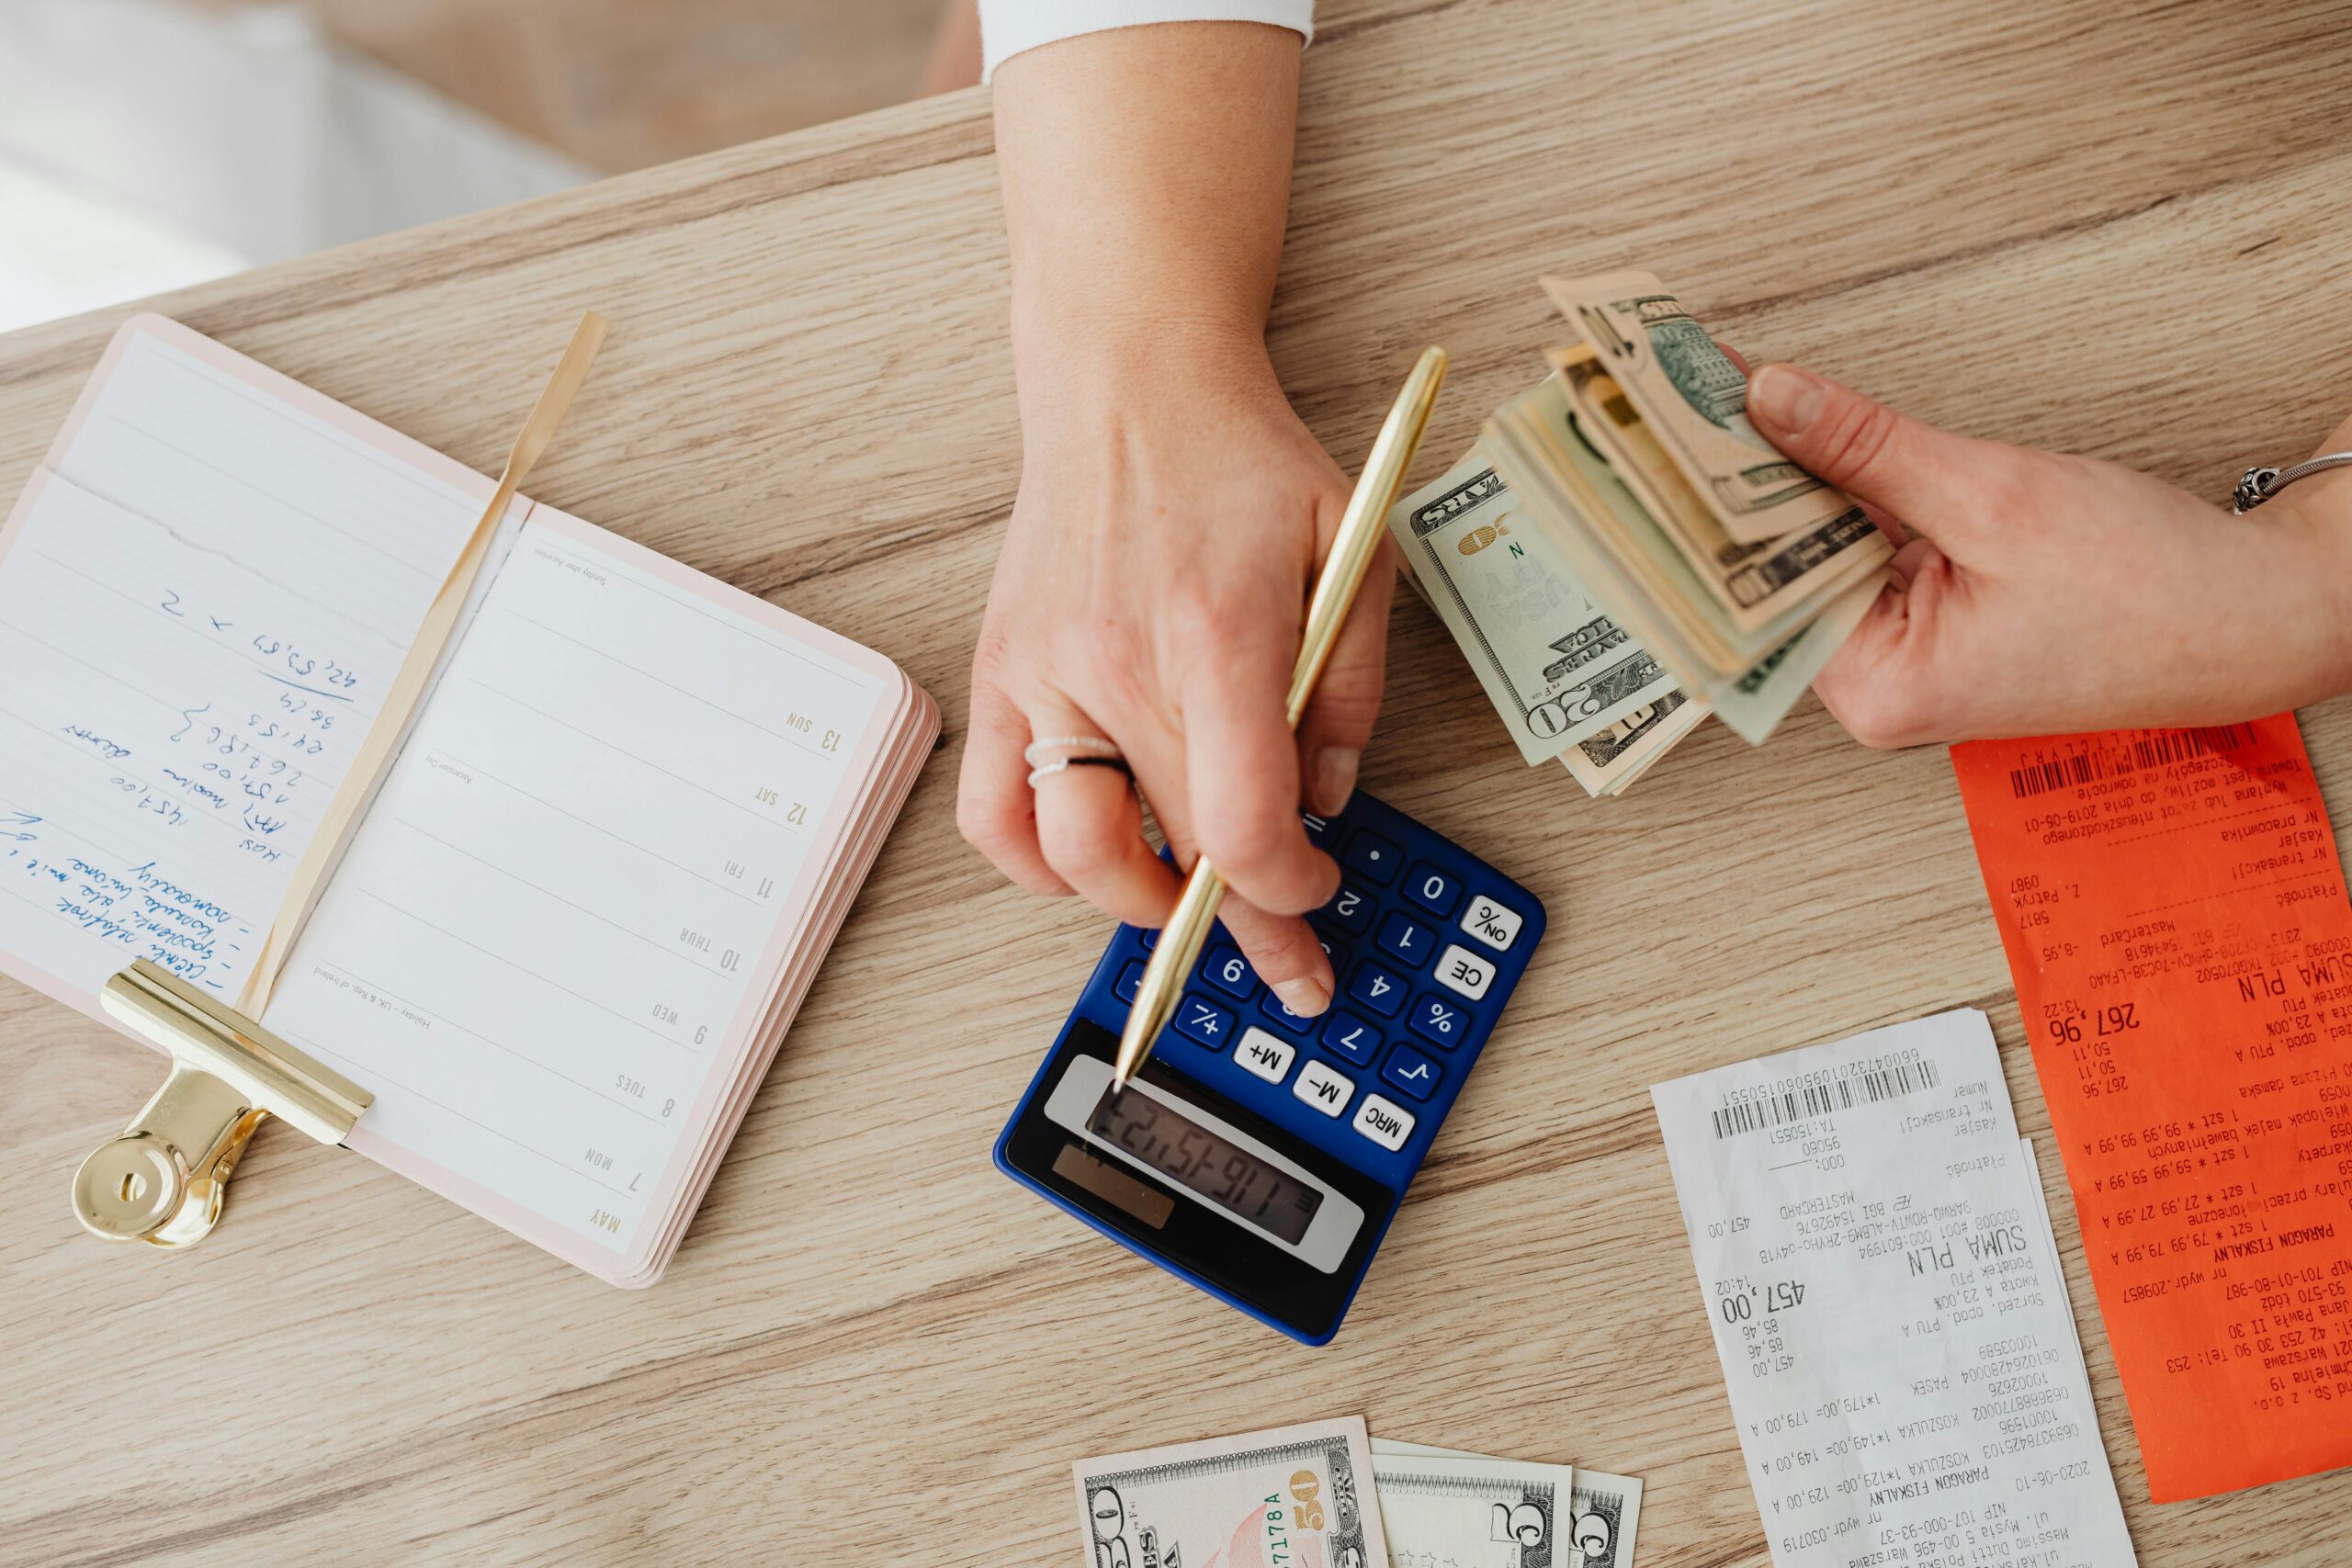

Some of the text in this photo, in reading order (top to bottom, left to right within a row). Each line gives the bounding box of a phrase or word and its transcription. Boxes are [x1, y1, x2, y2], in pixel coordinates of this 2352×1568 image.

[565, 561, 582, 574] after
[581, 568, 607, 586] Sunday
[1528, 684, 1600, 739] 20
[785, 711, 842, 752] 13 SUN
[424, 755, 472, 784] Ascension Day
[2165, 751, 2235, 781] Szczegóły
[2222, 766, 2252, 786] jest
[754, 785, 808, 826] 12 SAT
[2041, 779, 2288, 846] Wymiana nieuszkodzonego
[2221, 814, 2296, 841] pracownika
[2278, 828, 2324, 848] Kasjer
[2231, 851, 2304, 879] transakcji
[722, 859, 775, 899] 11 FRI
[1423, 876, 1444, 899] 0
[2009, 874, 2039, 893] 0987
[2013, 889, 2059, 909] Patryk
[2275, 882, 2337, 908] Płatność
[2019, 910, 2049, 929] 5817
[1337, 892, 1483, 987] CE 1 2
[2099, 919, 2176, 948] MasterCard
[678, 927, 742, 973] 10 THUR
[2041, 941, 2079, 962] -8,95
[313, 966, 340, 985] Ireland
[339, 979, 349, 988] of
[2296, 953, 2352, 988] SUMA
[350, 984, 368, 999] Rep.
[1372, 976, 1391, 997] 4
[2237, 969, 2285, 1002] PLN
[377, 998, 392, 1010] UK
[1223, 958, 1364, 1050] 7 9
[2042, 998, 2080, 1018] 13:22
[2282, 997, 2306, 1014] PTU
[400, 1008, 431, 1029] Holiday
[651, 1002, 709, 1045] 9 WED
[2048, 999, 2140, 1045] 267,96
[2265, 1013, 2312, 1036] 23,00%
[1250, 1044, 1282, 1070] M+
[2073, 1040, 2110, 1061] 50,11
[2249, 1032, 2317, 1059] opod. PTU
[2077, 1058, 2116, 1079] 50,11
[615, 1073, 675, 1118] 8 TUES
[2082, 1075, 2128, 1099] 267,96
[2238, 1078, 2284, 1100] damska
[1366, 1108, 1402, 1138] MRC
[1769, 1117, 1836, 1145] TA:150551
[1802, 1103, 1971, 1156] transakcji 95060
[1953, 1115, 1996, 1137] Kasjer
[2147, 1101, 2349, 1159] Wielopak majek bawełnianych
[2098, 1122, 2181, 1153] 99,99 99,99
[584, 1147, 643, 1191] 7 MON
[2109, 1157, 2192, 1190] 59,99 59,99
[1707, 1153, 2006, 1237] Płatność MASTERCARD 457,00
[2160, 1193, 2199, 1215] 27,99
[589, 1208, 621, 1233] MAY
[1795, 1210, 1855, 1235] 15492676
[1906, 1224, 2027, 1276] SUMA PLN
[2126, 1231, 2209, 1262] 79,99 79,99
[2212, 1224, 2334, 1262] PARAGON FISKALNY
[1950, 1255, 2033, 1287] Podatek PTU
[2225, 1266, 2324, 1300] 701-01-80-987
[1714, 1274, 1750, 1295] 14:02
[2122, 1270, 2205, 1303] wydr.209857
[2297, 1280, 2345, 1303] 93-570
[1720, 1278, 1806, 1324] 457,00
[1933, 1287, 1979, 1310] 23,00%
[1741, 1317, 1779, 1340] 85,46
[2228, 1323, 2245, 1338] 30
[2273, 1307, 2313, 1328] Pawła
[1747, 1336, 1783, 1359] 85,46
[2165, 1330, 2304, 1373] 253 253
[2263, 1346, 2326, 1370] Warszawa
[1751, 1353, 1794, 1377] 457,00
[1910, 1375, 1949, 1396] PASEK
[2269, 1376, 2285, 1392] 19
[1764, 1410, 1808, 1433] 179,00
[1897, 1412, 1960, 1438] KOSZULKA
[1775, 1447, 1818, 1471] 149,00
[1907, 1450, 1970, 1477] KOSZULKA
[1869, 1465, 1989, 1506] PARAGON FISKALNY
[2015, 1461, 2090, 1491] 2020-06-10
[1287, 1467, 1324, 1533] 50
[1786, 1484, 1829, 1508] 129,00
[1880, 1502, 2007, 1545] NIP 107-000-93-37
[1848, 1517, 2019, 1568] Mysia 00-496 Warszawa
[1972, 1541, 2009, 1562] Dutti
[2015, 1527, 2069, 1551] Massimo
